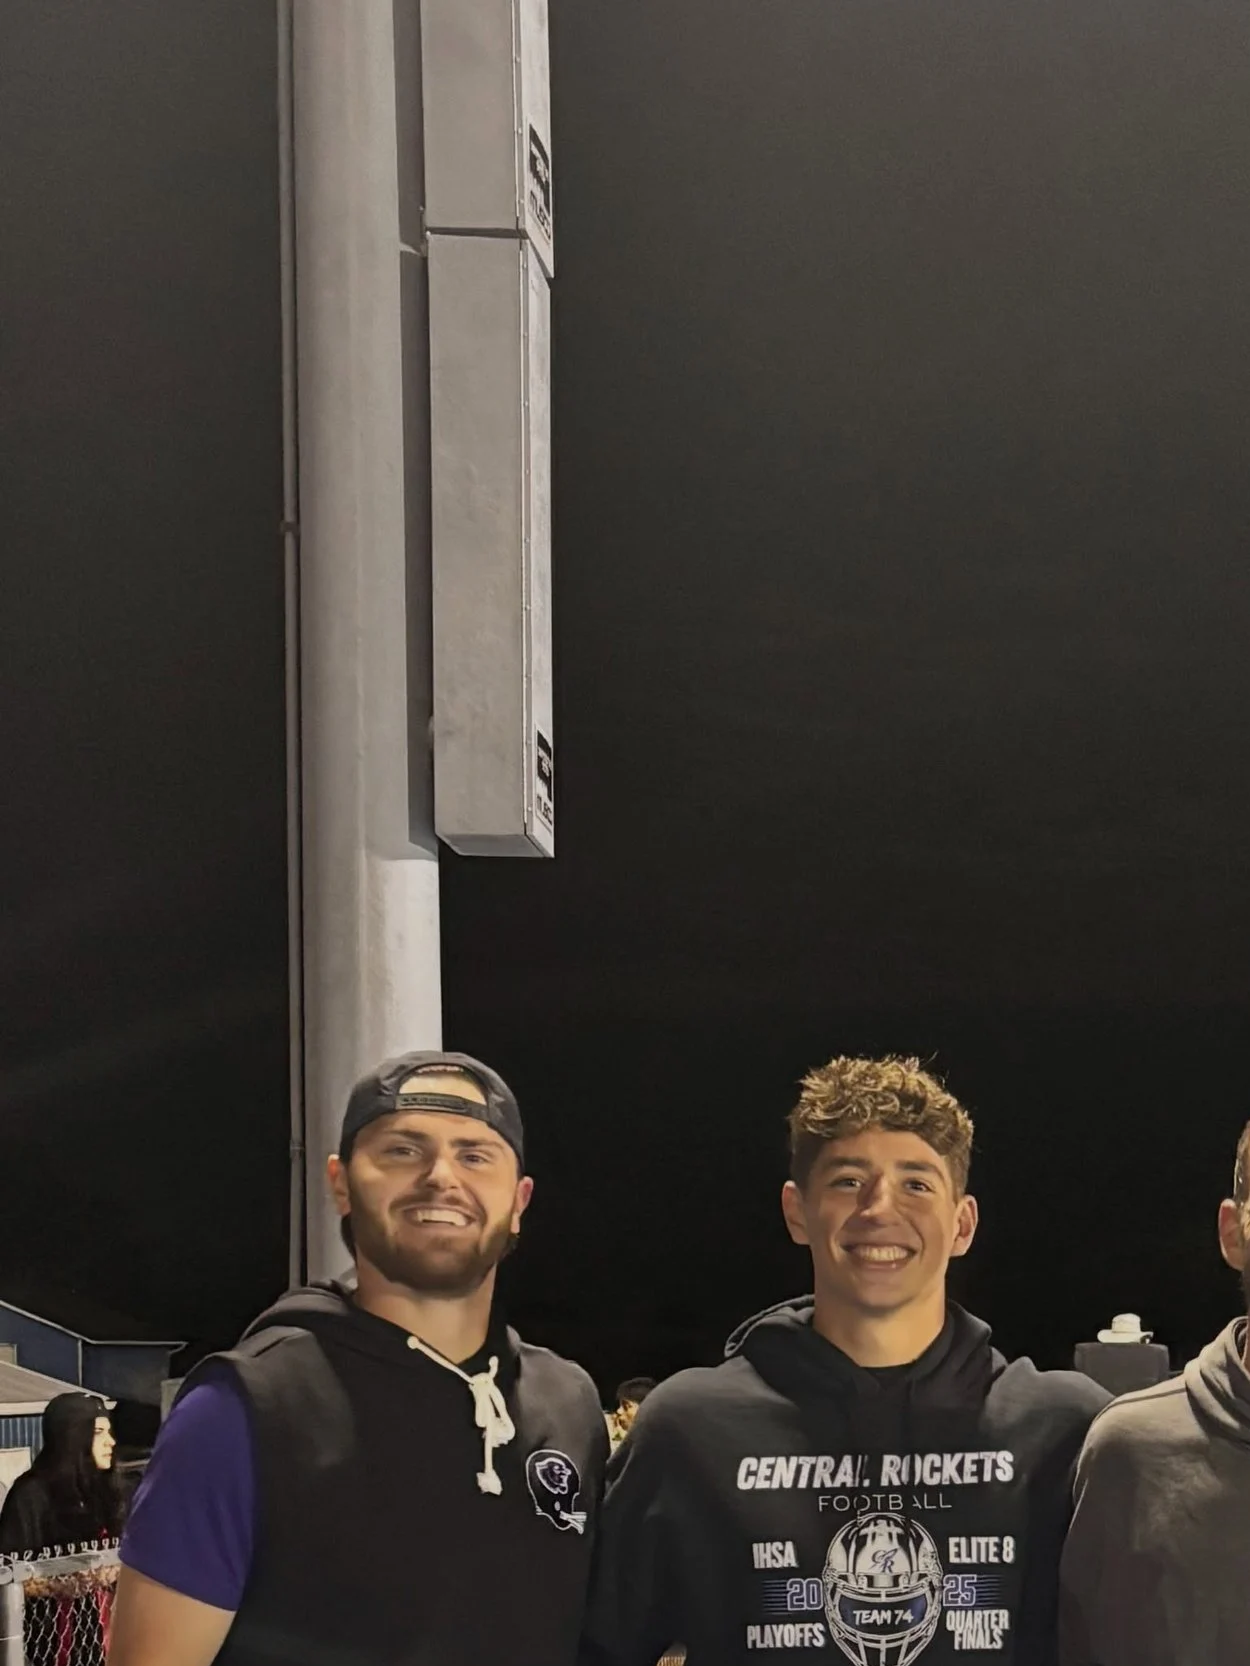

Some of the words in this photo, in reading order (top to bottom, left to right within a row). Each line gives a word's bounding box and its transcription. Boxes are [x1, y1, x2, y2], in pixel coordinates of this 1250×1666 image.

[880, 1450, 1014, 1487] ROCKETS
[818, 1492, 952, 1512] FOOTBALL
[752, 1540, 798, 1569] IHSA
[948, 1536, 1002, 1564] ELITE
[1003, 1535, 1015, 1564] 8
[786, 1577, 824, 1611] 20
[942, 1574, 978, 1607] 25
[852, 1609, 892, 1626] TEAM
[894, 1608, 914, 1626] 74
[946, 1609, 1010, 1632] QUARTER
[746, 1622, 826, 1649] PLAYOFFS
[953, 1628, 1004, 1650] FINALS
